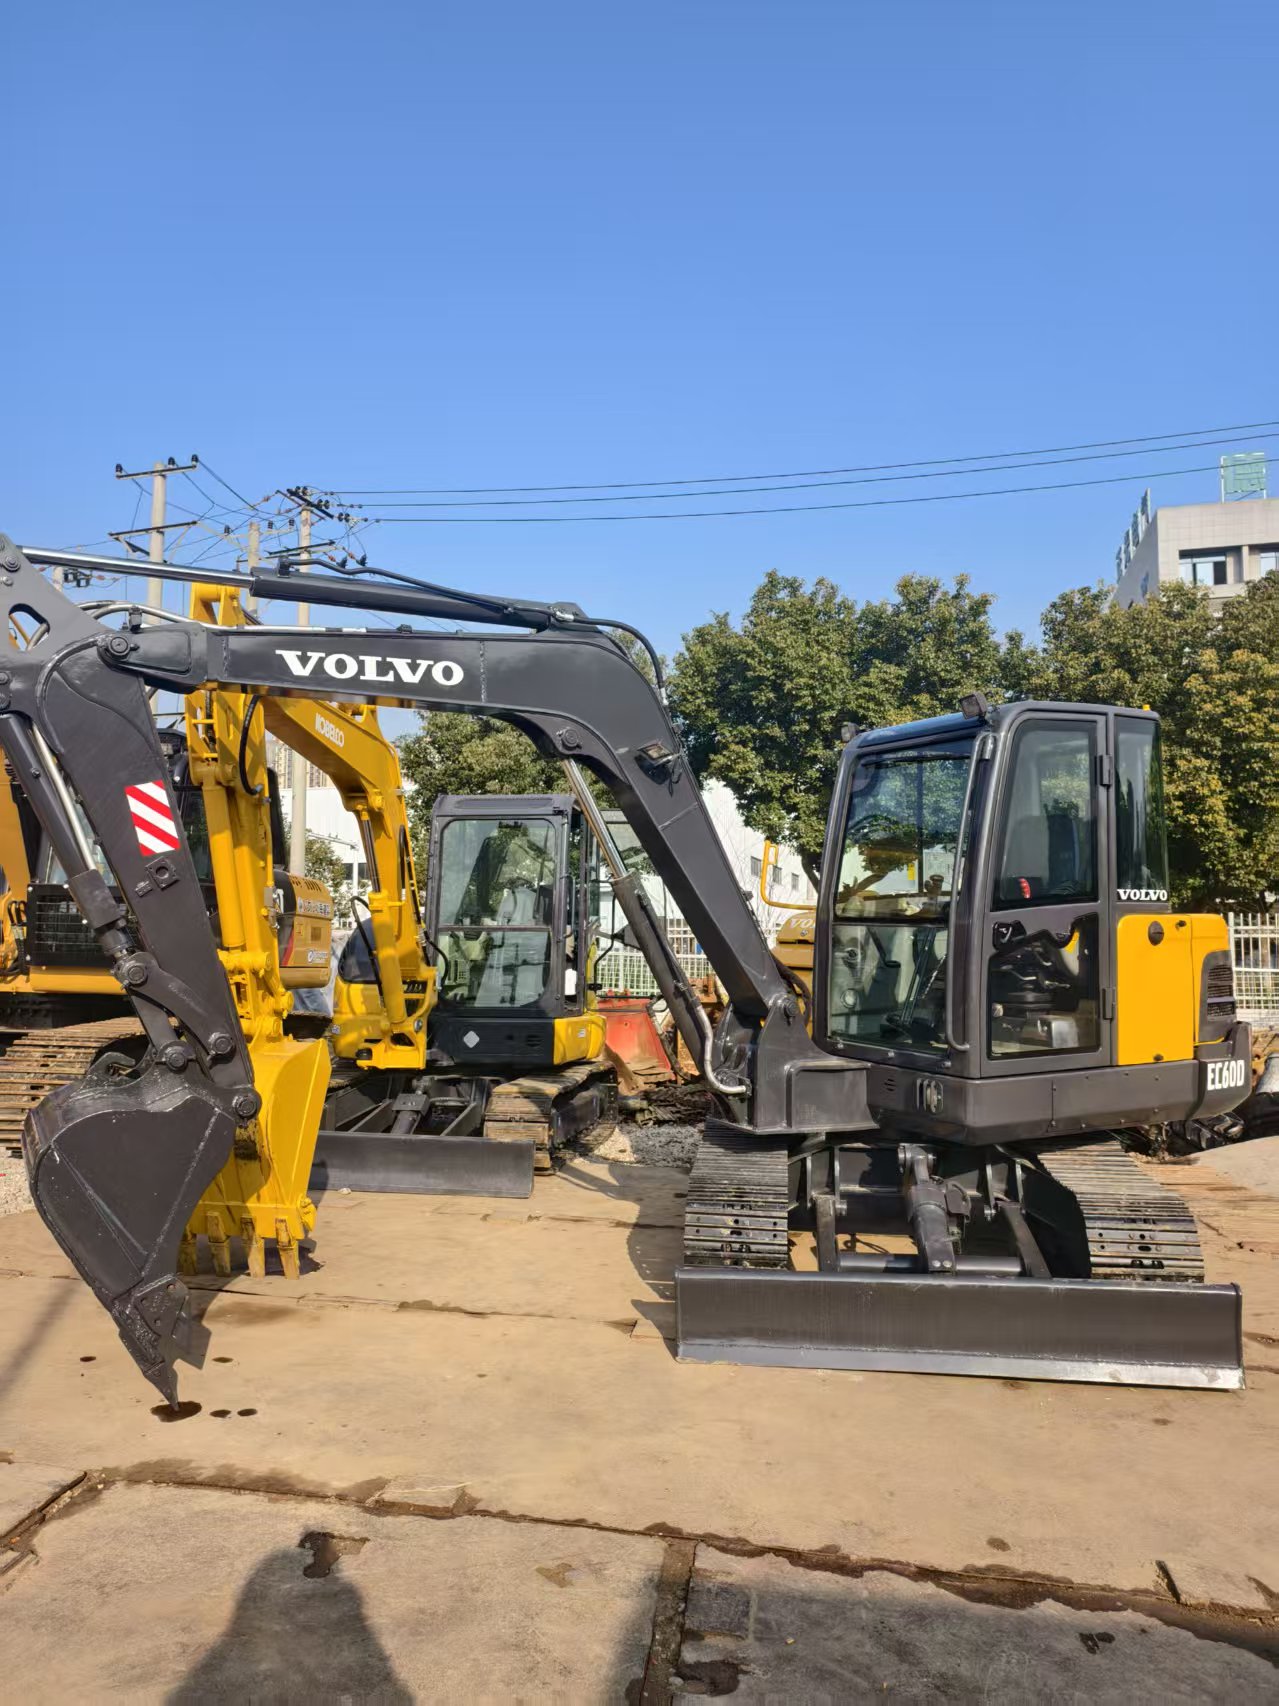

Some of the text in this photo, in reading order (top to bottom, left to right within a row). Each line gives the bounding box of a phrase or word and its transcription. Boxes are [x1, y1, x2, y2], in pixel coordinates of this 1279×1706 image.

[275, 650, 464, 686] VOLVO
[1117, 888, 1168, 901] VOLVO
[790, 919, 816, 929] VO
[1207, 1059, 1245, 1091] EC60D
